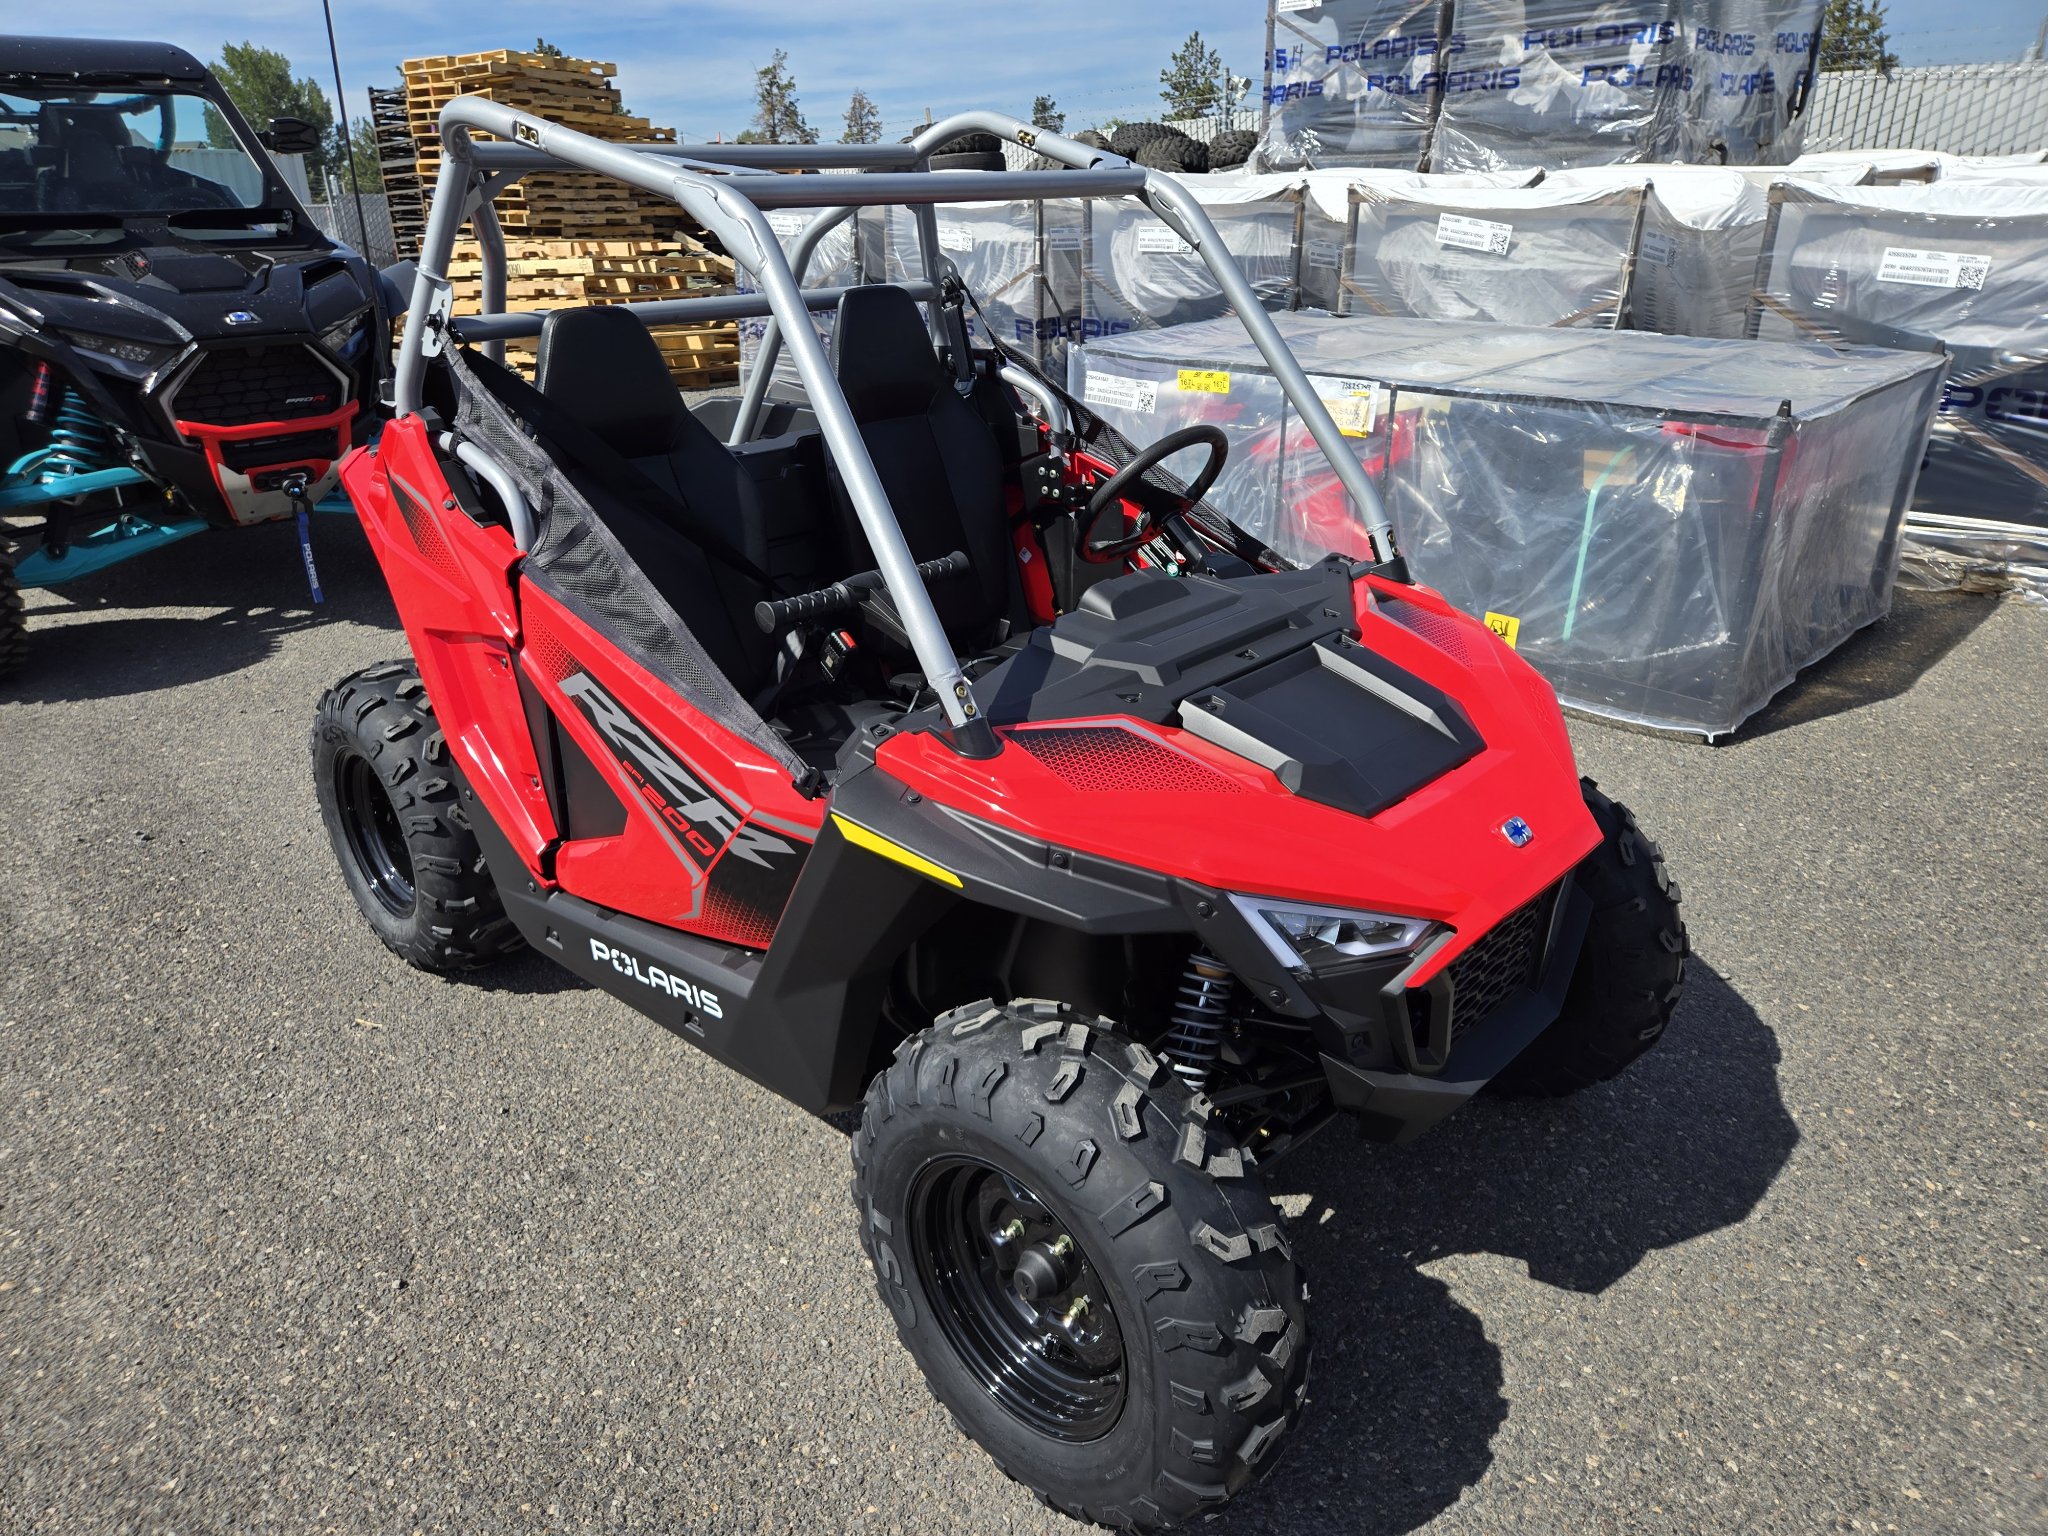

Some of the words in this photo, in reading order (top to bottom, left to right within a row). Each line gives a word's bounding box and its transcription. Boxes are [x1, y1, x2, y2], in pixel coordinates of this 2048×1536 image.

[1325, 33, 1438, 64] POLARIS
[1523, 20, 1675, 51] POLARIS
[303, 543, 320, 589] POLARIS
[557, 671, 797, 871] RZR
[641, 783, 716, 857] 200
[590, 938, 723, 1019] POLARIS
[866, 1191, 918, 1330] CST
